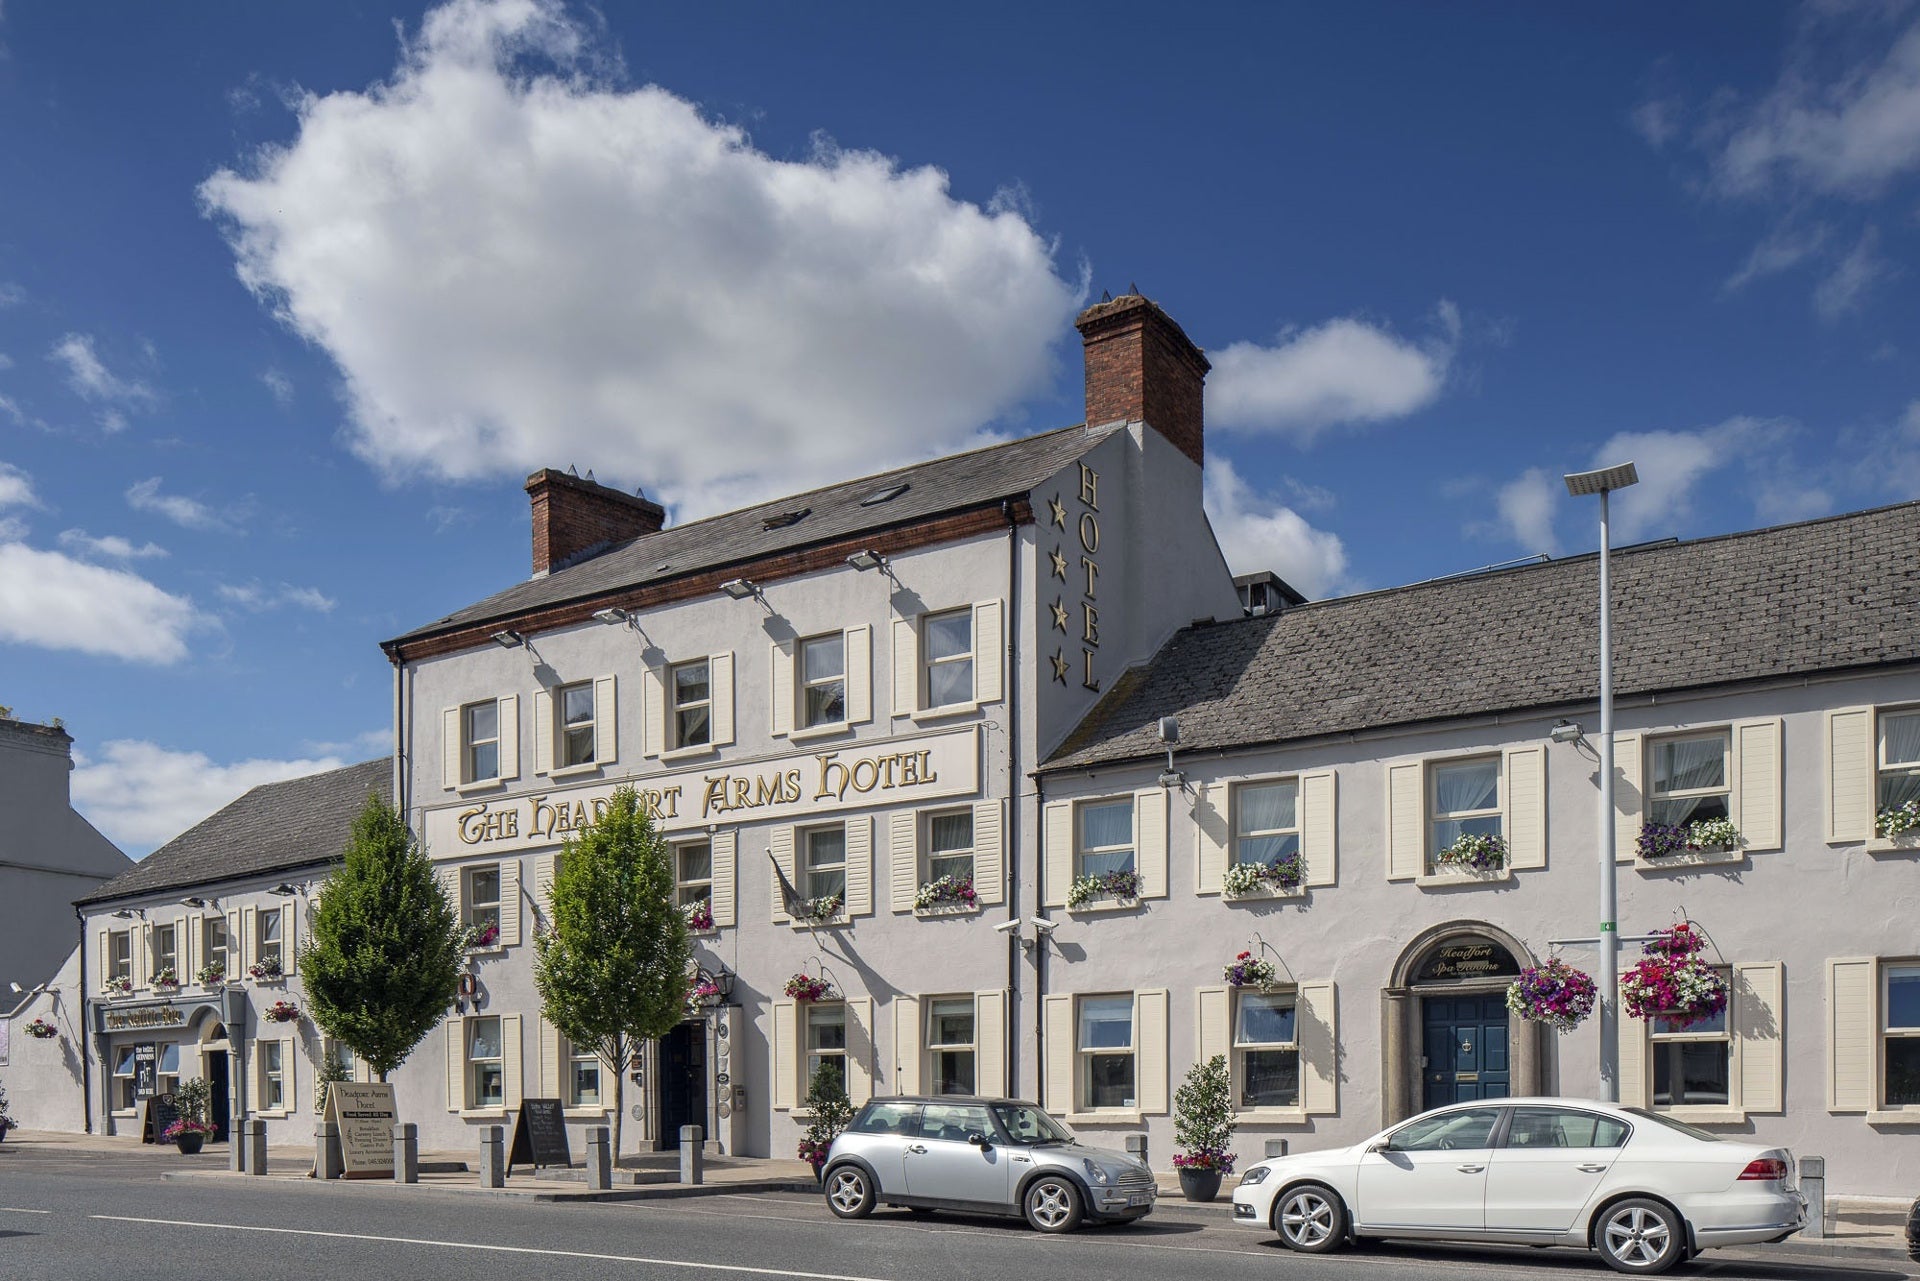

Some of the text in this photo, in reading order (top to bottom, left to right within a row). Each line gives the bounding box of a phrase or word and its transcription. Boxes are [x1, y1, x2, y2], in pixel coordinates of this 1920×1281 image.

[1077, 460, 1100, 694] HOTEL
[458, 802, 518, 844] THE
[701, 768, 801, 818] ARMS
[813, 750, 938, 802] HOTEL
[1440, 945, 1492, 960] Headfort
[1432, 961, 1455, 976] Spa
[135, 1053, 154, 1061] GUINNESS
